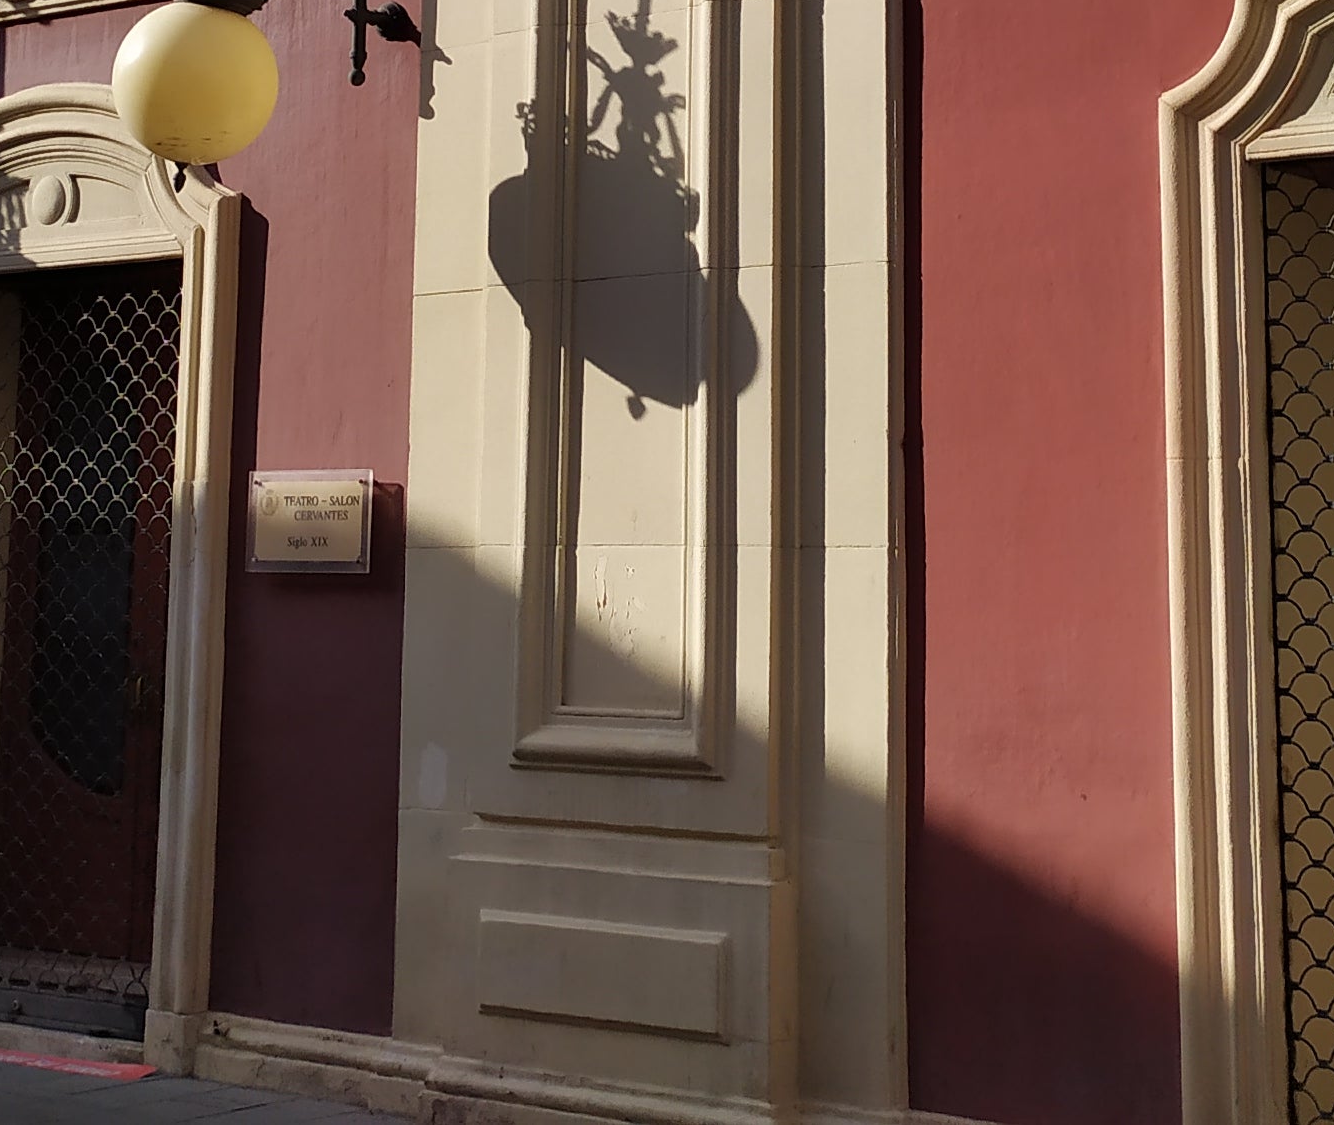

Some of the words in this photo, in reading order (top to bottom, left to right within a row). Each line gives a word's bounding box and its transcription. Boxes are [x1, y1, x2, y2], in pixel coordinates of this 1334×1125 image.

[283, 495, 319, 507] TEATRO
[328, 495, 361, 507] SALON
[294, 510, 349, 521] CERVANTES
[287, 536, 308, 549] Siglo
[310, 537, 329, 548] XIX
